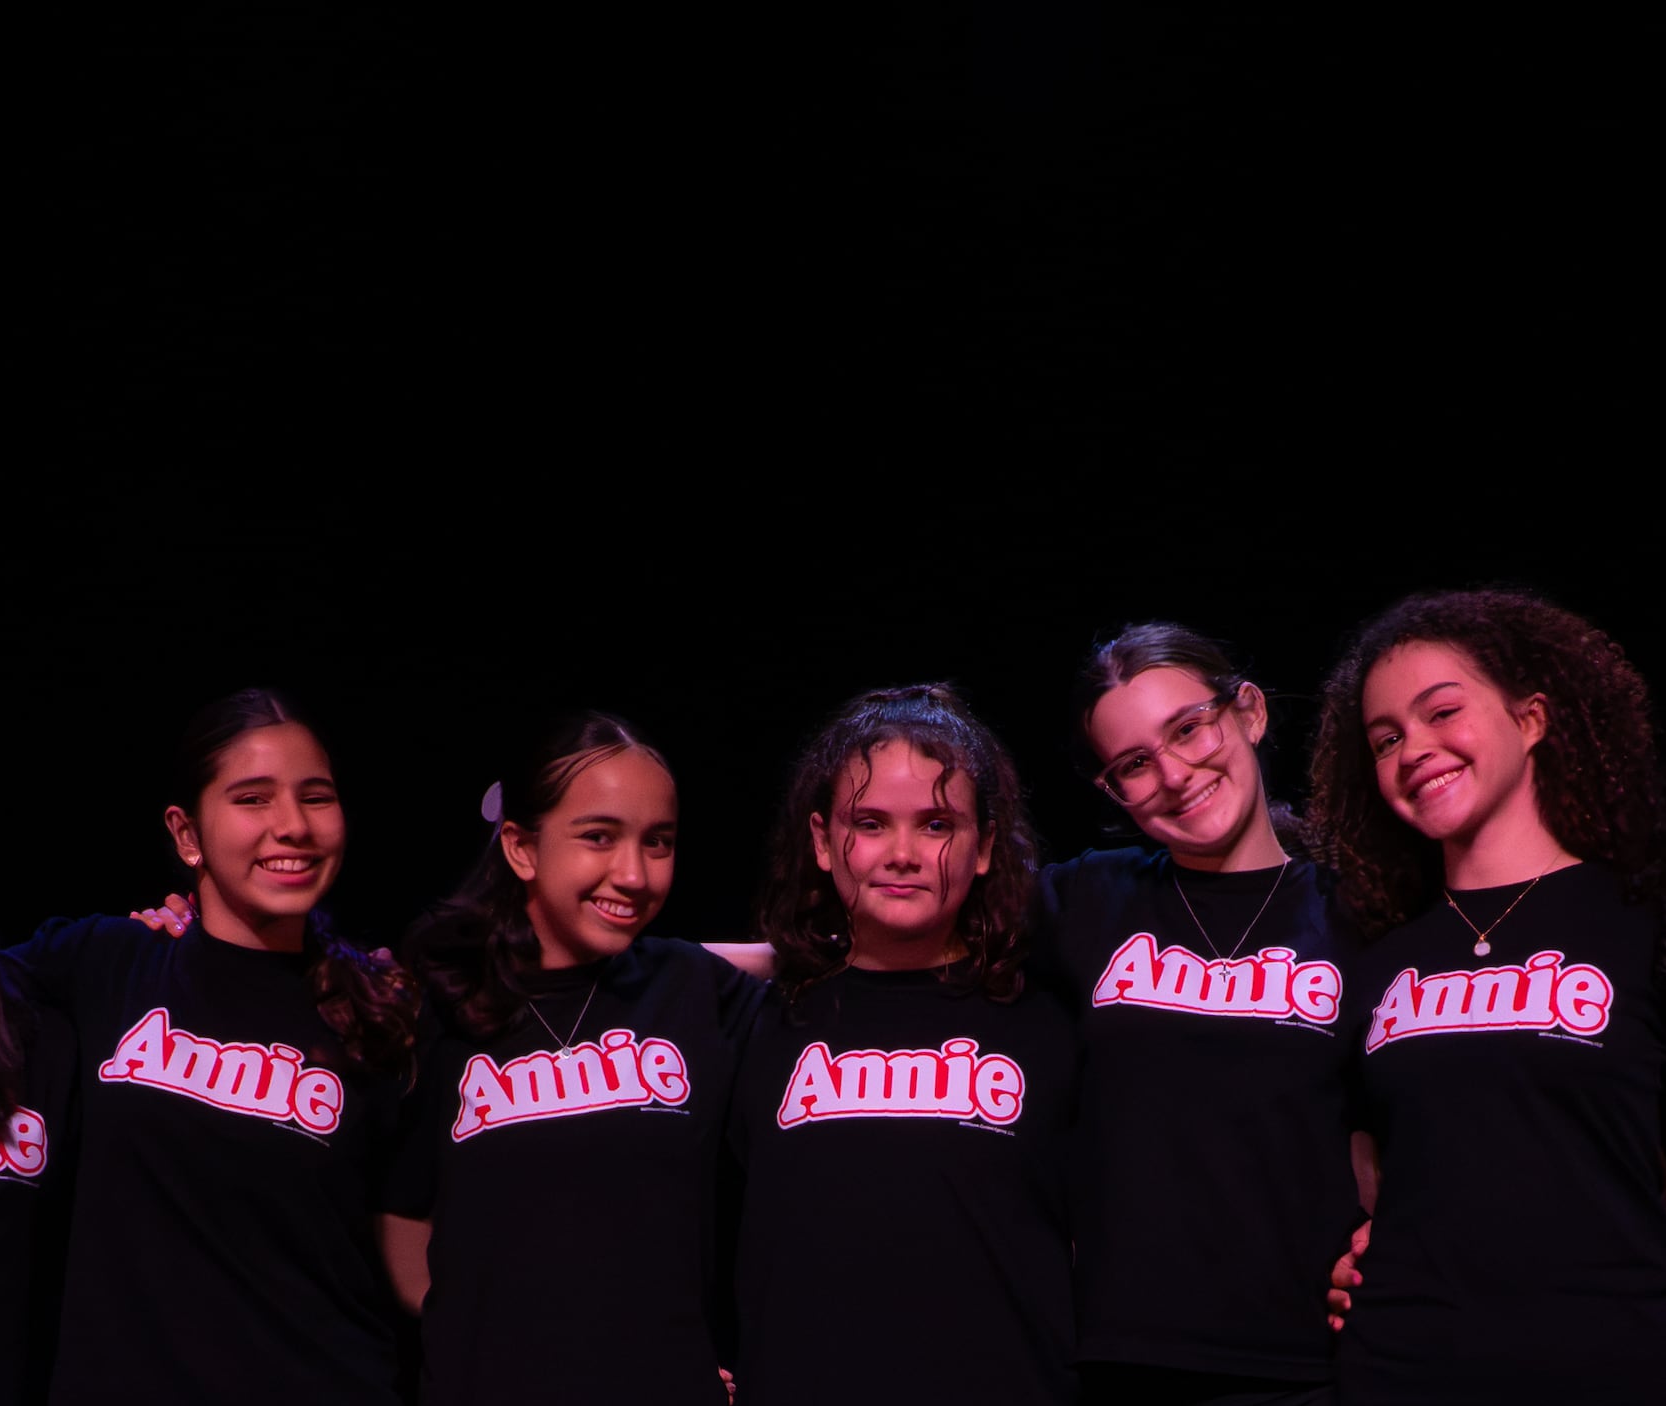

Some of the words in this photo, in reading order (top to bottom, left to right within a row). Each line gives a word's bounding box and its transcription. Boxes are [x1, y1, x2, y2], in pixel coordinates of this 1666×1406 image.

[1093, 931, 1342, 1024] Annie
[1366, 950, 1613, 1055] Annie
[99, 1008, 344, 1135] Annie
[452, 1028, 691, 1142] Annie
[777, 1037, 1025, 1129] Annie
